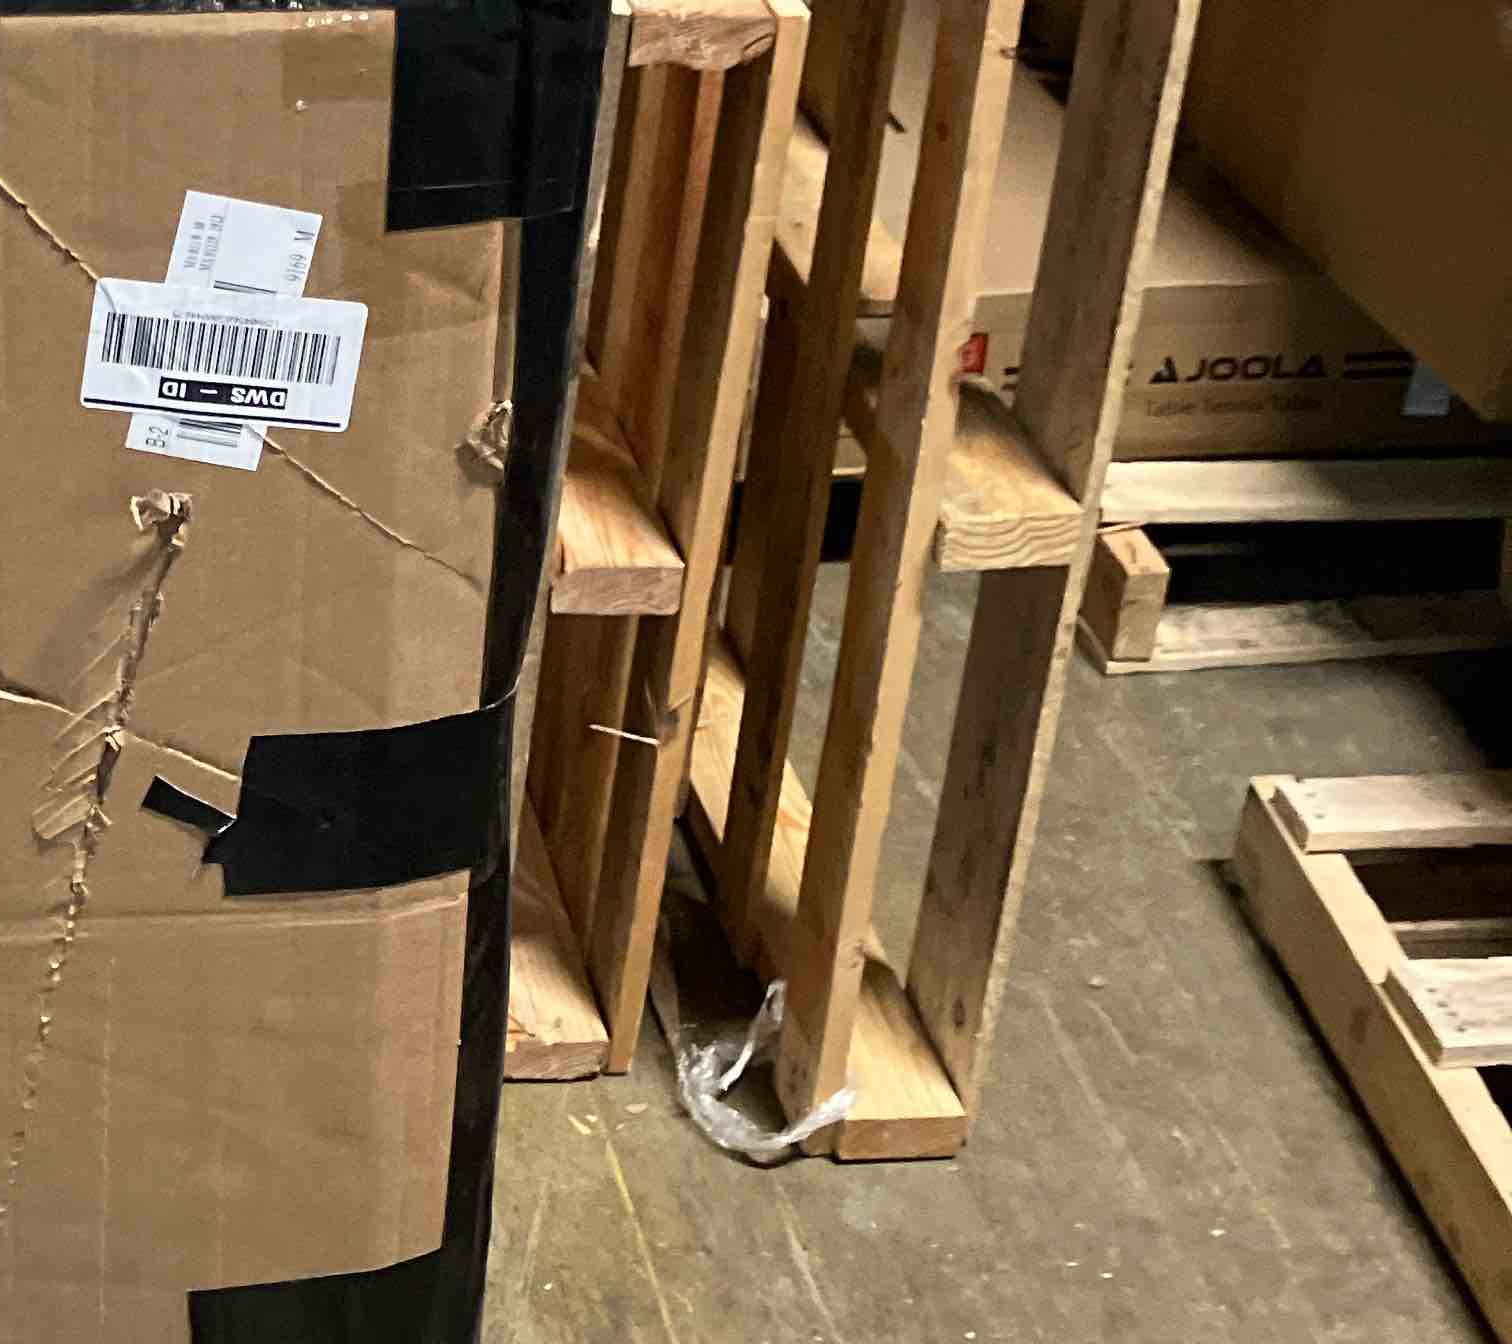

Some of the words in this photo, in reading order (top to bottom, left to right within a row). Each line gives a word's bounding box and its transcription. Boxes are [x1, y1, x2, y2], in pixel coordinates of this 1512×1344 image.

[1185, 353, 1327, 383] JOOLA
[162, 381, 187, 398] ID
[230, 386, 286, 407] DWS
